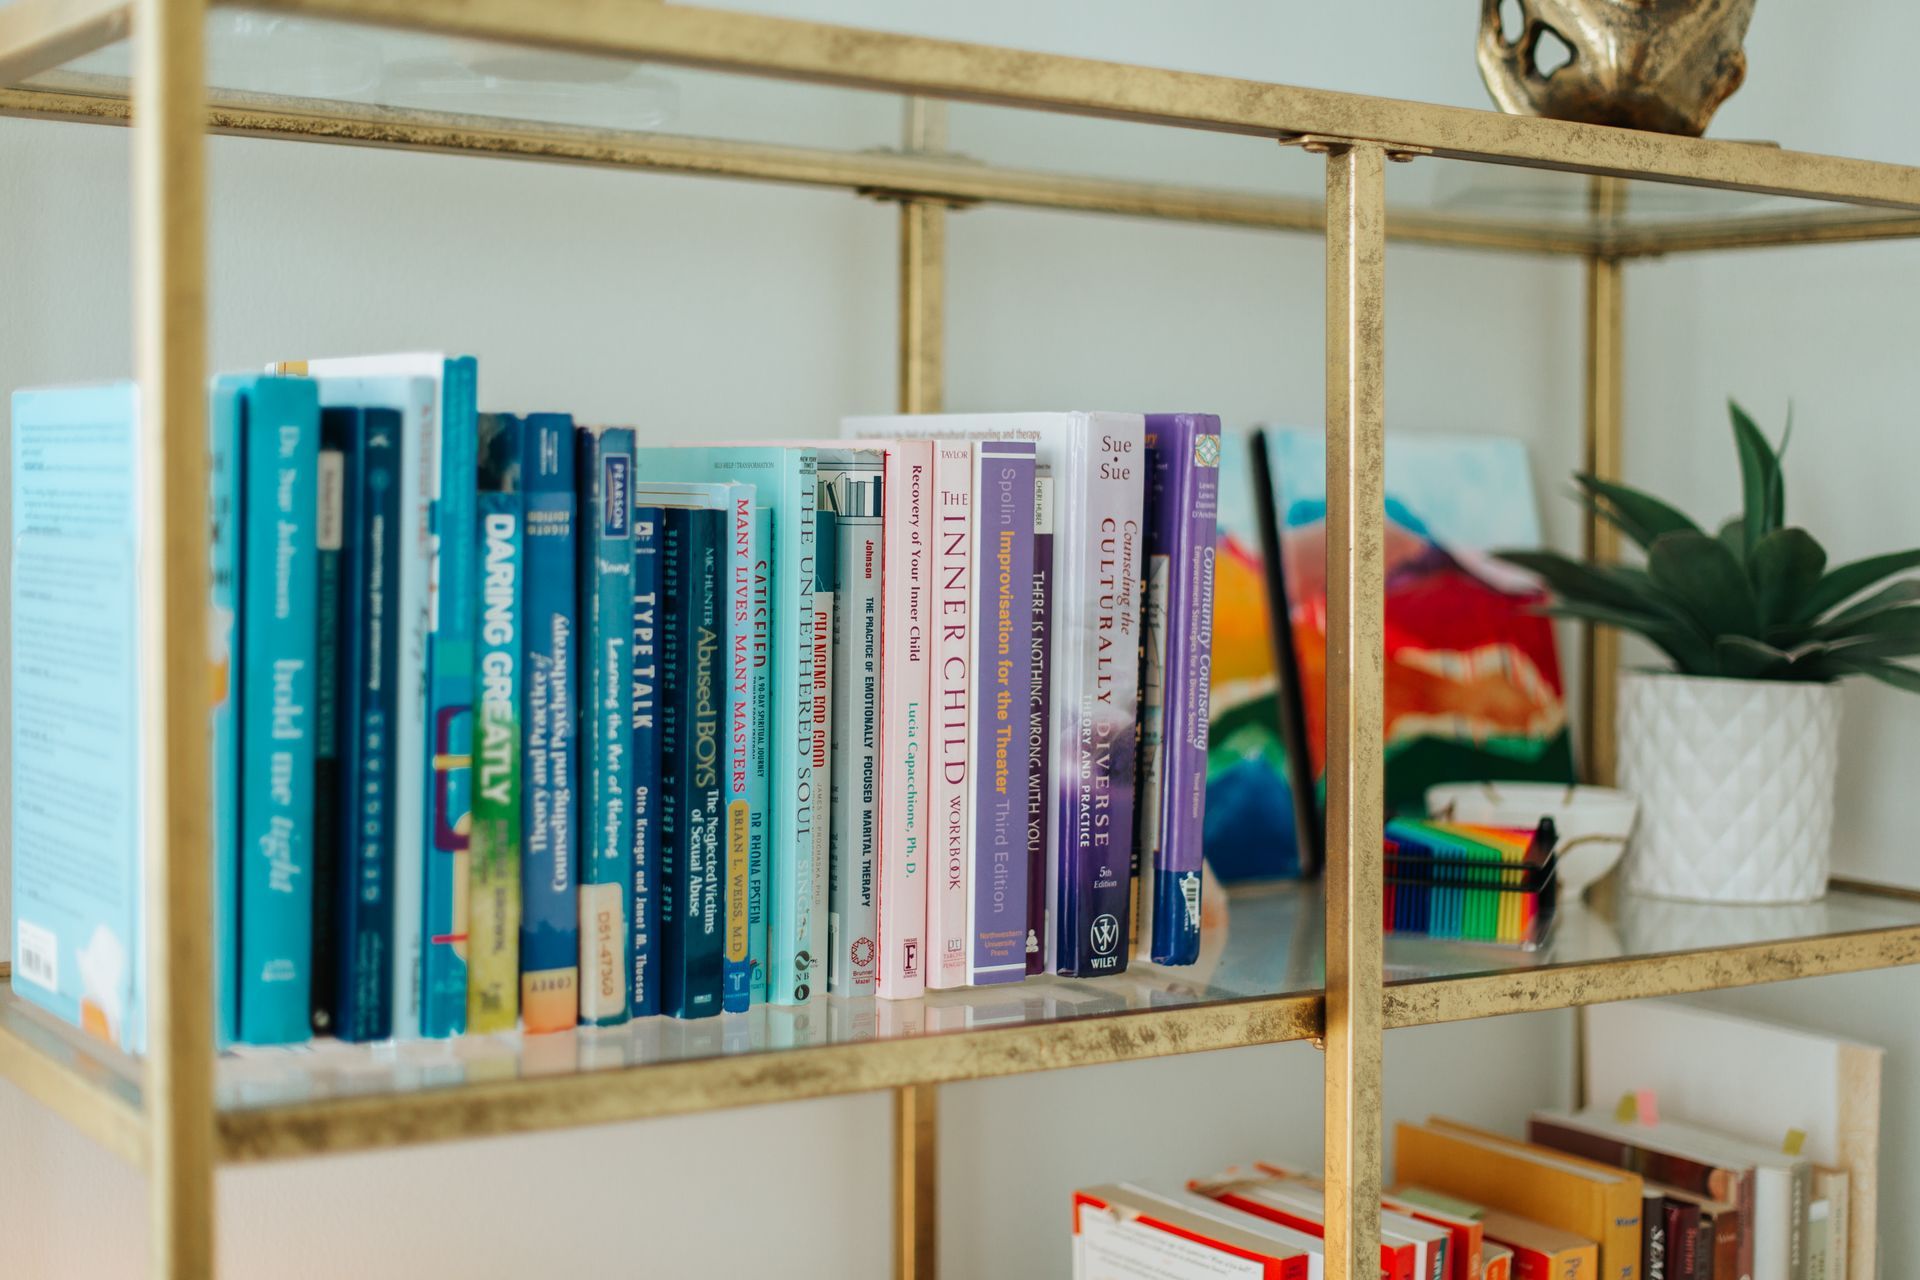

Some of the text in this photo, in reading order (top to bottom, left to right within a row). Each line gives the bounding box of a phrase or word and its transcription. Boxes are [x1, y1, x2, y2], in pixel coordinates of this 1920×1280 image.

[941, 450, 968, 459] TAYLOR
[1003, 429, 1015, 440] and
[1016, 428, 1042, 441] therapy,
[1100, 463, 1130, 480] Sue
[1101, 435, 1132, 453] Sue
[613, 463, 625, 529] PEARSON
[801, 485, 815, 545] THE
[941, 490, 969, 506] THE
[1035, 503, 1043, 526] HUBER
[484, 513, 516, 646] DARING
[704, 547, 715, 626] MIC HUNTER
[865, 539, 875, 579] Johnson
[909, 464, 923, 662] Recovery of Your Inner Child
[1117, 520, 1138, 636] Counseling the
[1192, 545, 1202, 607] Empowerment
[632, 592, 655, 729] TYPE TALK
[734, 498, 749, 793] MANY LIVES, MANY MASTERS
[799, 556, 814, 757] UNTETHERED
[1190, 609, 1200, 652] Strategies
[1190, 655, 1198, 667] for
[1193, 546, 1215, 752] Community Counseling
[531, 674, 549, 747] Practice
[695, 626, 718, 788] Abused BOYS
[758, 682, 766, 709] 90-DAY
[814, 612, 827, 768] CHANGING FOR GOOD
[944, 515, 967, 891] INNER CHILD WORKBOOK
[994, 467, 1016, 913] Spolin Improvisation for the Theater Third Edition
[1028, 570, 1044, 851] THERE IS NOTHING WRONG WITH YOU
[1095, 517, 1116, 847] CULTURALLY DIVERSE
[1189, 678, 1198, 709] Diverse
[480, 652, 514, 805] GREATLY
[551, 612, 571, 892] Counseling and Psychotherapy
[605, 637, 624, 860] Learning the Art of Helping
[757, 709, 766, 745] SPIRITUAL
[757, 747, 765, 778] JOURNEY
[862, 596, 875, 908] THE PRACTICE OF EMOTIONALLY FOCUSED MARITAL THERAPY
[1187, 712, 1197, 744] Society
[260, 659, 304, 893] hold me tight
[530, 750, 548, 786] and
[797, 767, 812, 843] SOUL
[905, 702, 919, 879] Lucia Capacchione, Ph. D.
[1080, 694, 1092, 848] THEORY AND PRACTICE
[530, 788, 549, 853] Theory
[752, 812, 762, 828] DR
[752, 834, 762, 875] RHONA
[635, 786, 649, 1003] Otto Kroeger and Janet M. Thuesen
[690, 808, 704, 917] of Sexual Abuse
[704, 788, 719, 935] The Neglected Victims
[732, 808, 745, 956] BRIAN L. WEISS, M.D.
[1093, 880, 1118, 889] Edition
[1099, 866, 1112, 877] 5th
[984, 939, 1017, 948] University
[1090, 956, 1118, 969] WILEY
